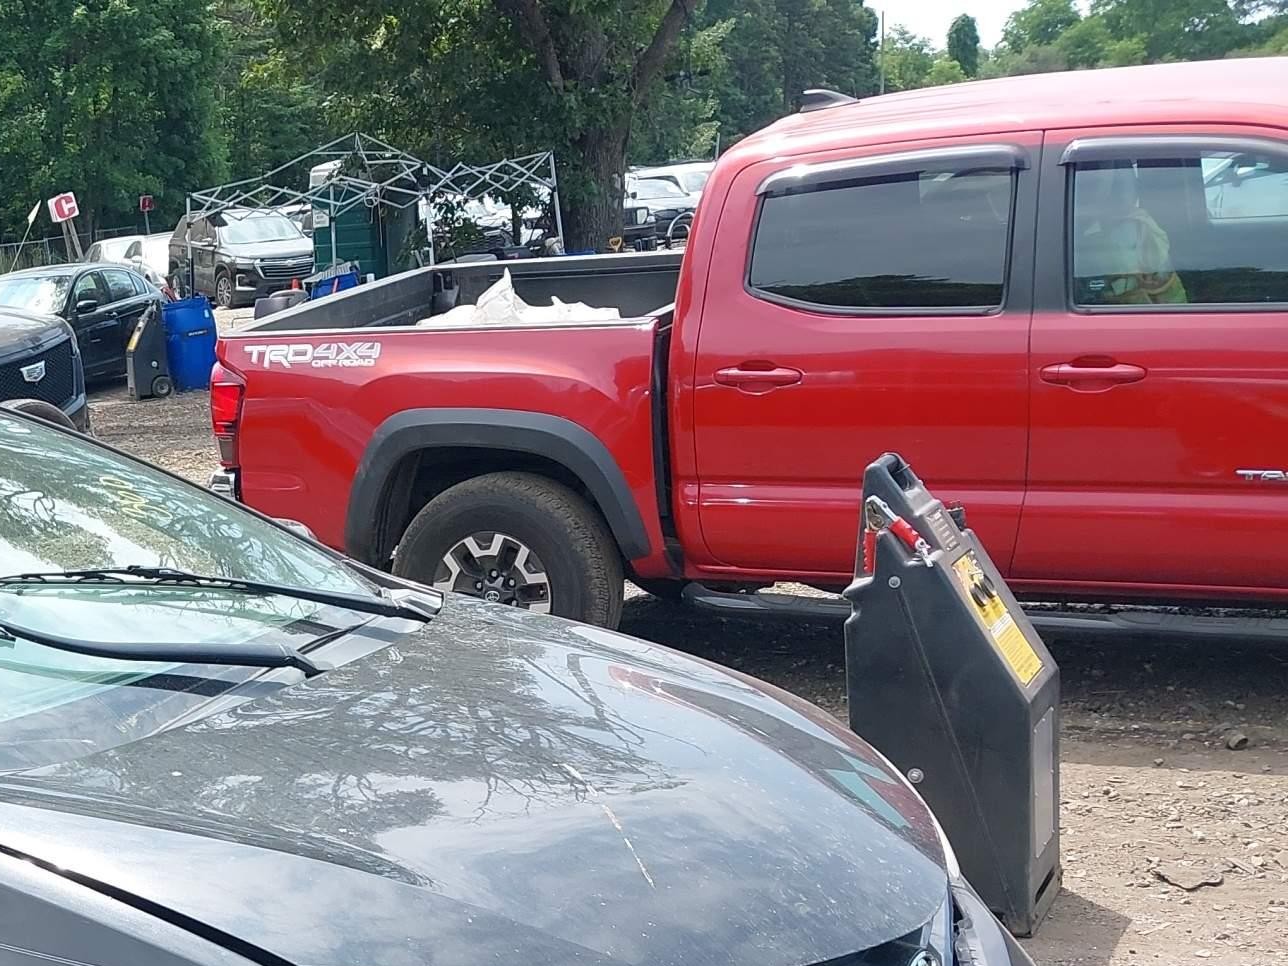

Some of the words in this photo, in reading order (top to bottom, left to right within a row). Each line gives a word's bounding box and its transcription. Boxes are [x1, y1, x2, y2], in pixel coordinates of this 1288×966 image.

[54, 195, 76, 219] C
[244, 343, 313, 369] TRD
[311, 359, 338, 368] OFF
[339, 358, 375, 368] ROAD
[1235, 468, 1288, 481] TA
